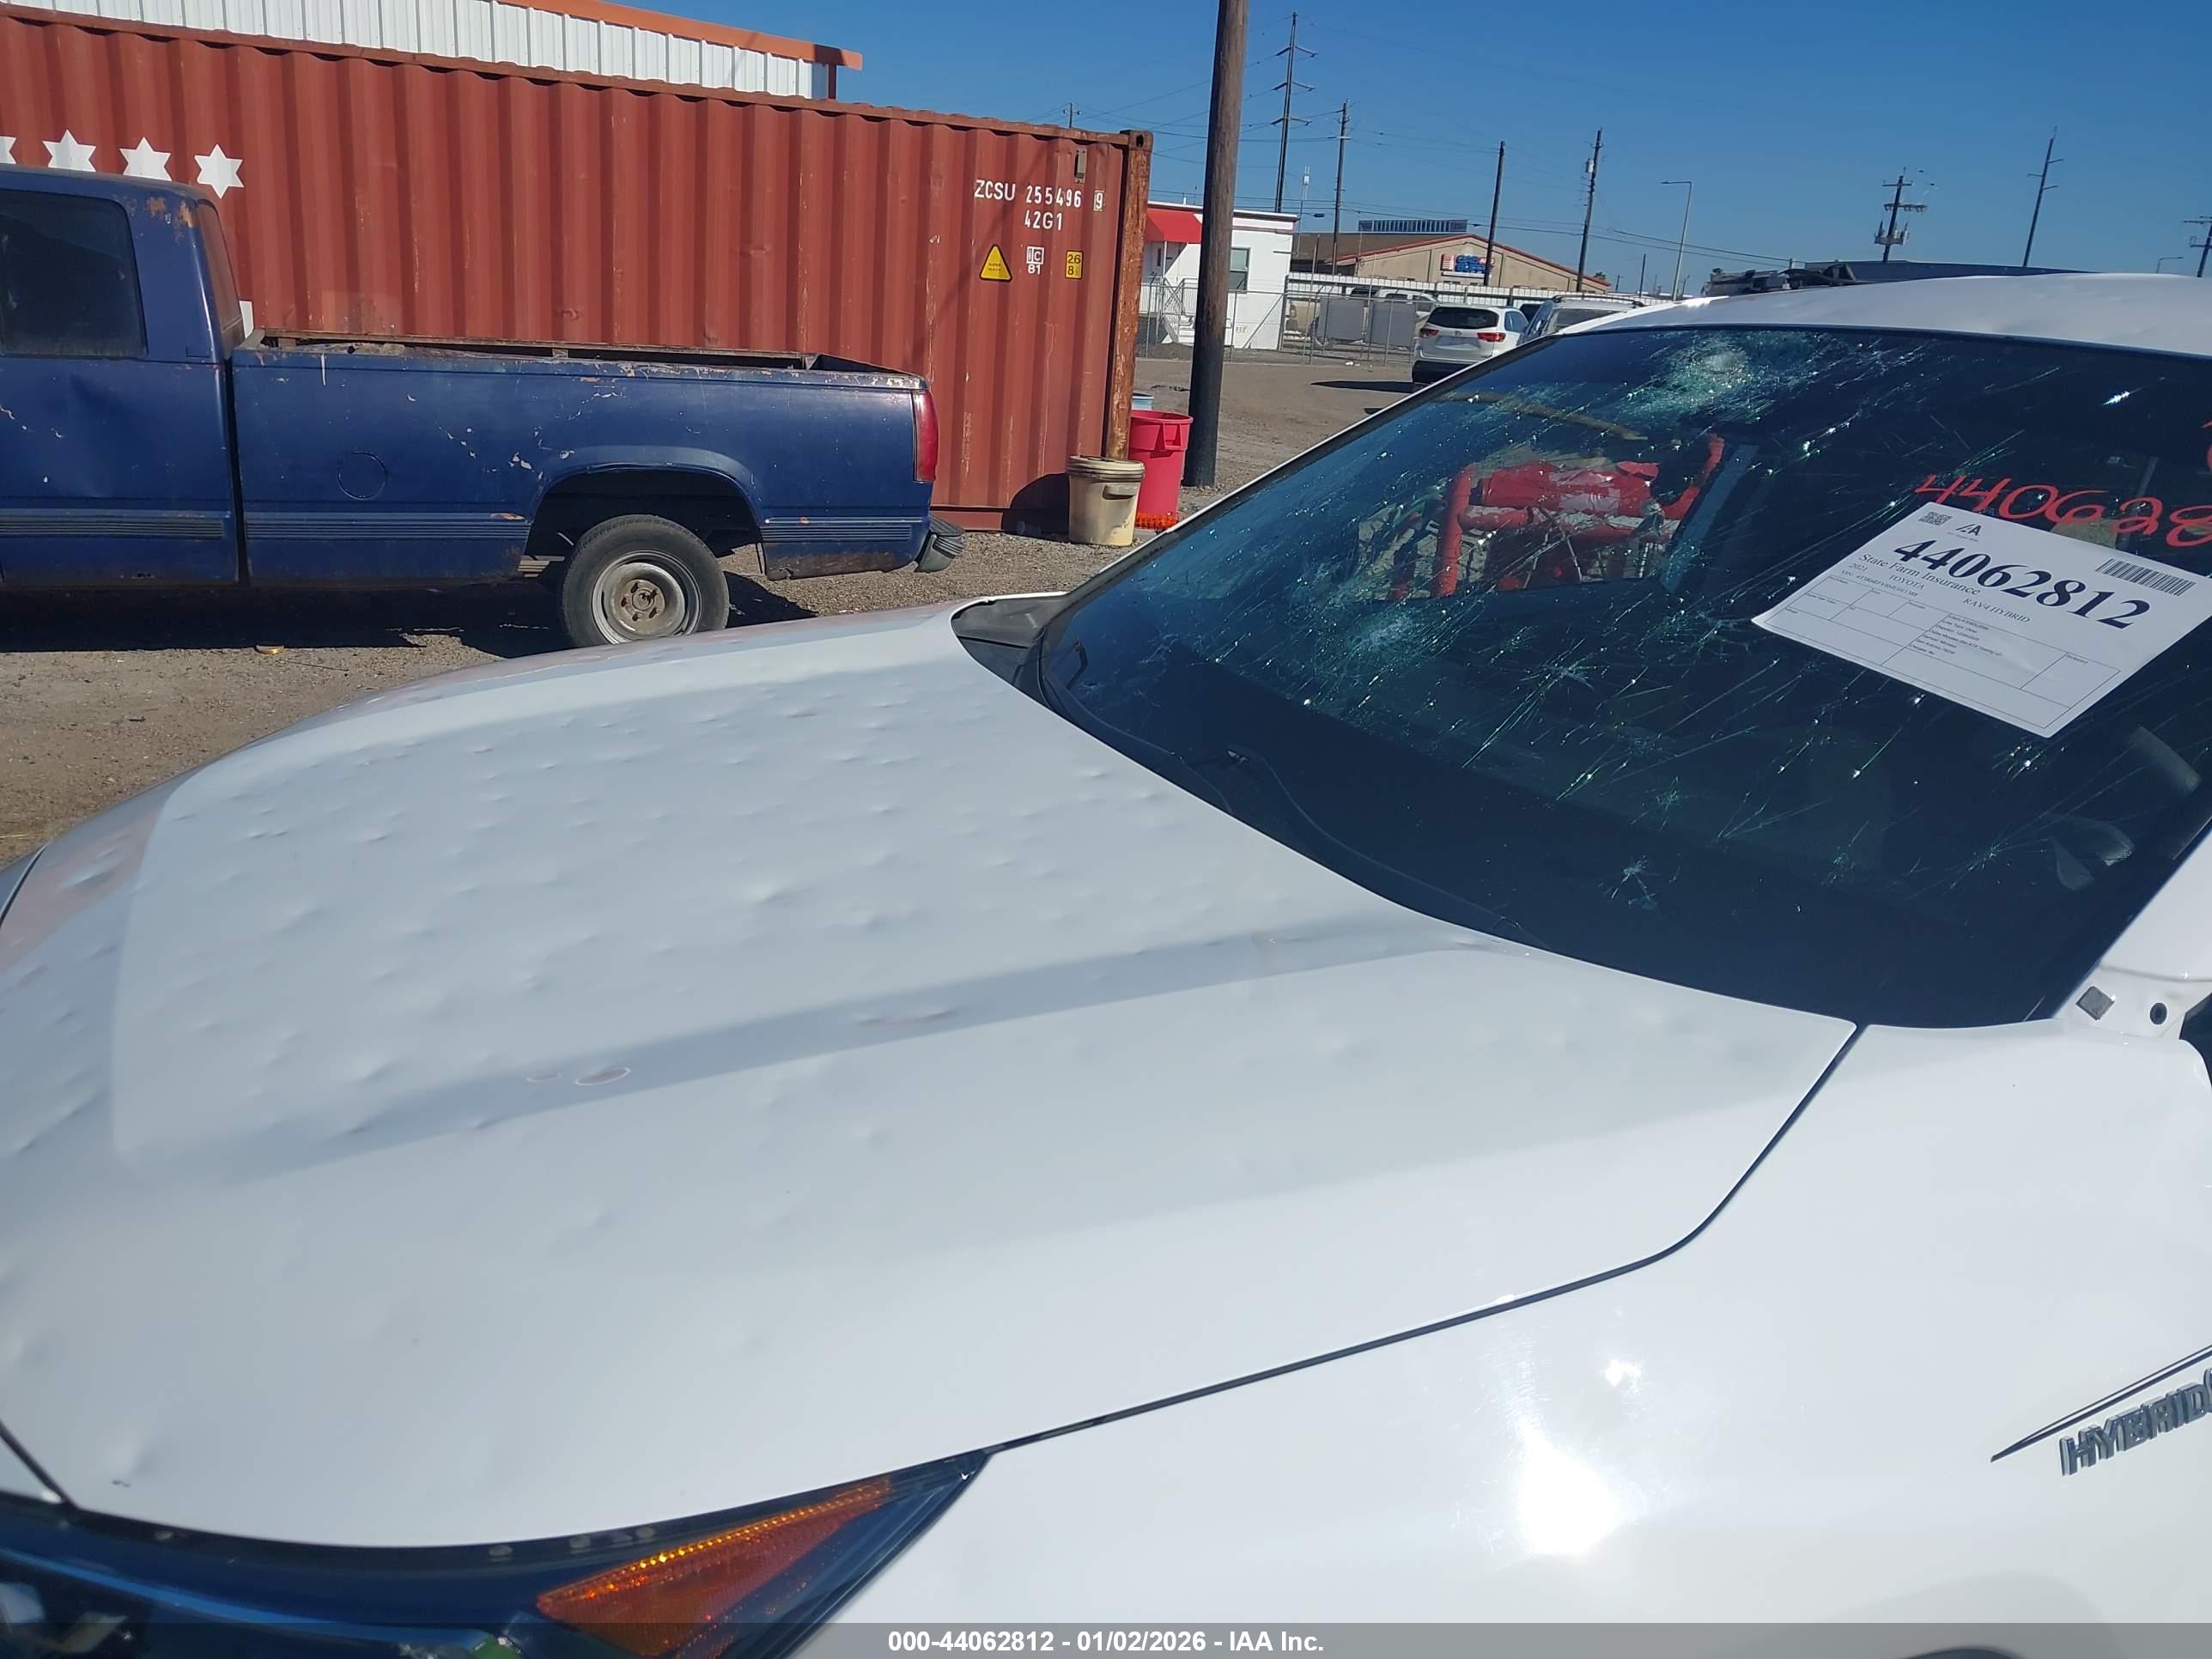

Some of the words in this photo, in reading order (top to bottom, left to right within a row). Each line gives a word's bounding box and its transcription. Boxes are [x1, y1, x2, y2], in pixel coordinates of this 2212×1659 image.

[974, 179, 1017, 202] ZCSU
[1025, 185, 1082, 208] 255496
[1094, 191, 1104, 210] 9
[1024, 210, 1062, 231] 42G1
[1027, 264, 1042, 275] 81
[1067, 253, 1081, 264] 26
[1858, 552, 1889, 568] State
[1888, 562, 1919, 578] Farm
[1921, 572, 1981, 596] Insurance
[1893, 538, 2151, 629] 44062812
[1888, 574, 1925, 590] TOYOTA
[1990, 605, 2031, 623] HYBRID
[2059, 1381, 2209, 1477] HYBRID
